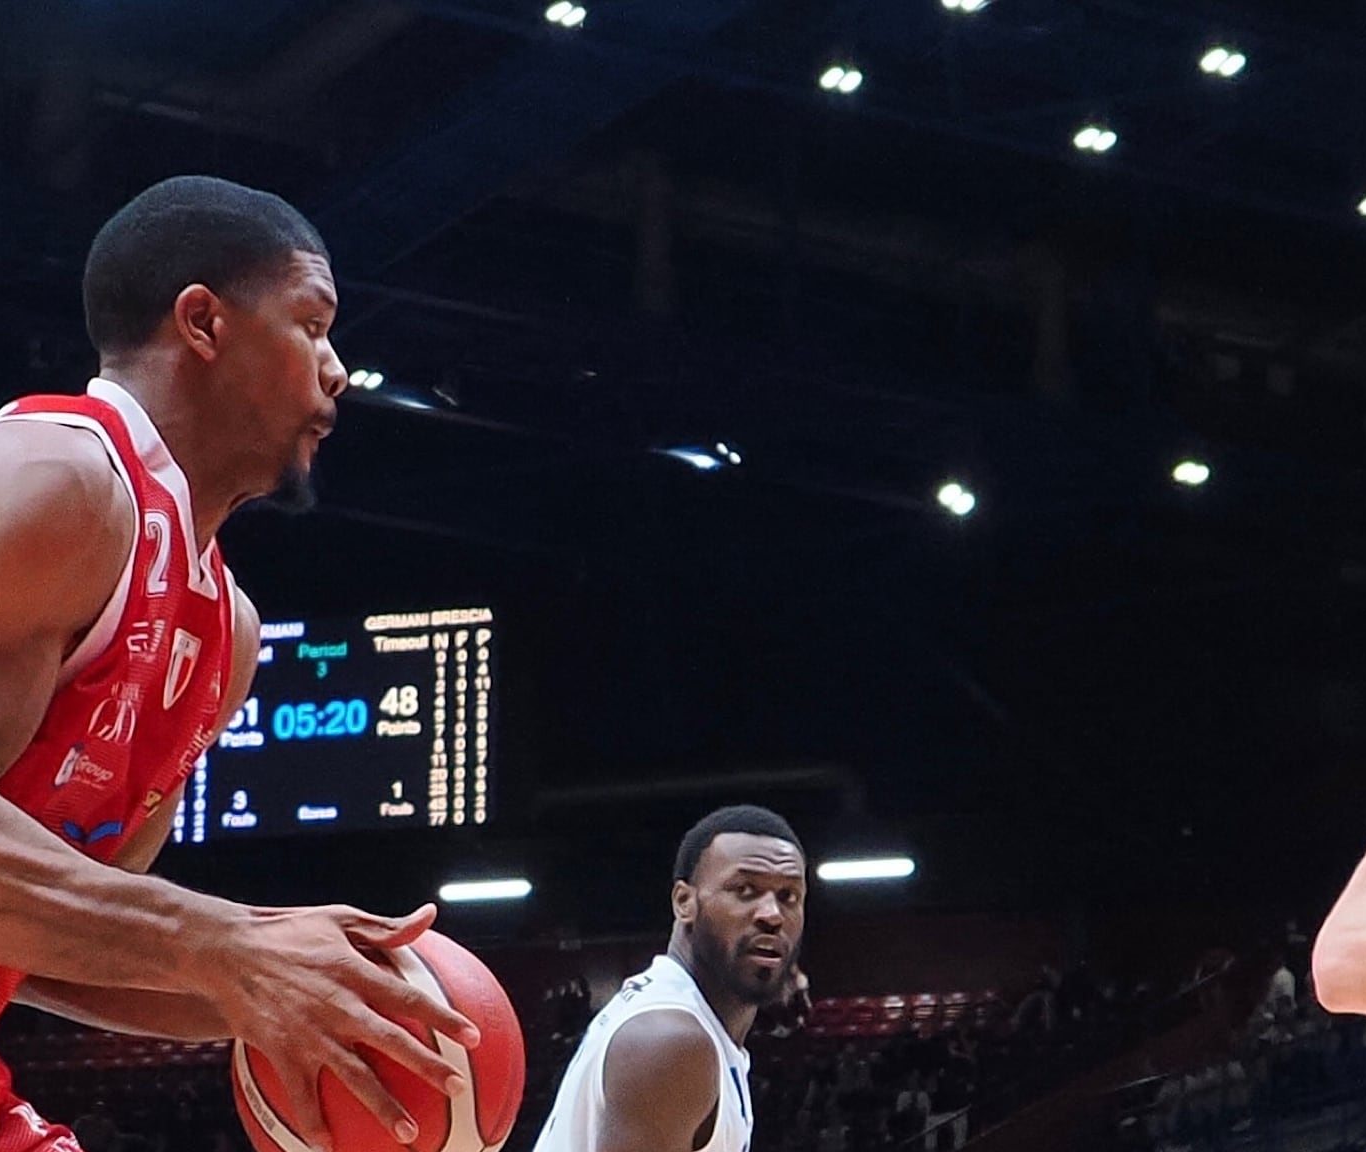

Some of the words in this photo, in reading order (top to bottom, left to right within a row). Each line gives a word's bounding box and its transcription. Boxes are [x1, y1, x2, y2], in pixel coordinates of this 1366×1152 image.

[144, 511, 170, 598] 2
[364, 612, 429, 631] GERMANI
[431, 608, 492, 626] BRESCIA
[298, 642, 347, 660] Period
[374, 634, 429, 652] Timeout
[317, 661, 328, 678] 3
[437, 666, 445, 678] 1
[458, 665, 466, 677] 1
[475, 676, 491, 690] 11
[379, 685, 418, 716] 48
[272, 698, 367, 740] 05:20
[377, 720, 421, 737] Points
[219, 731, 264, 748] Points
[431, 754, 447, 767] 11
[391, 781, 402, 798] 1
[234, 790, 247, 810] 3
